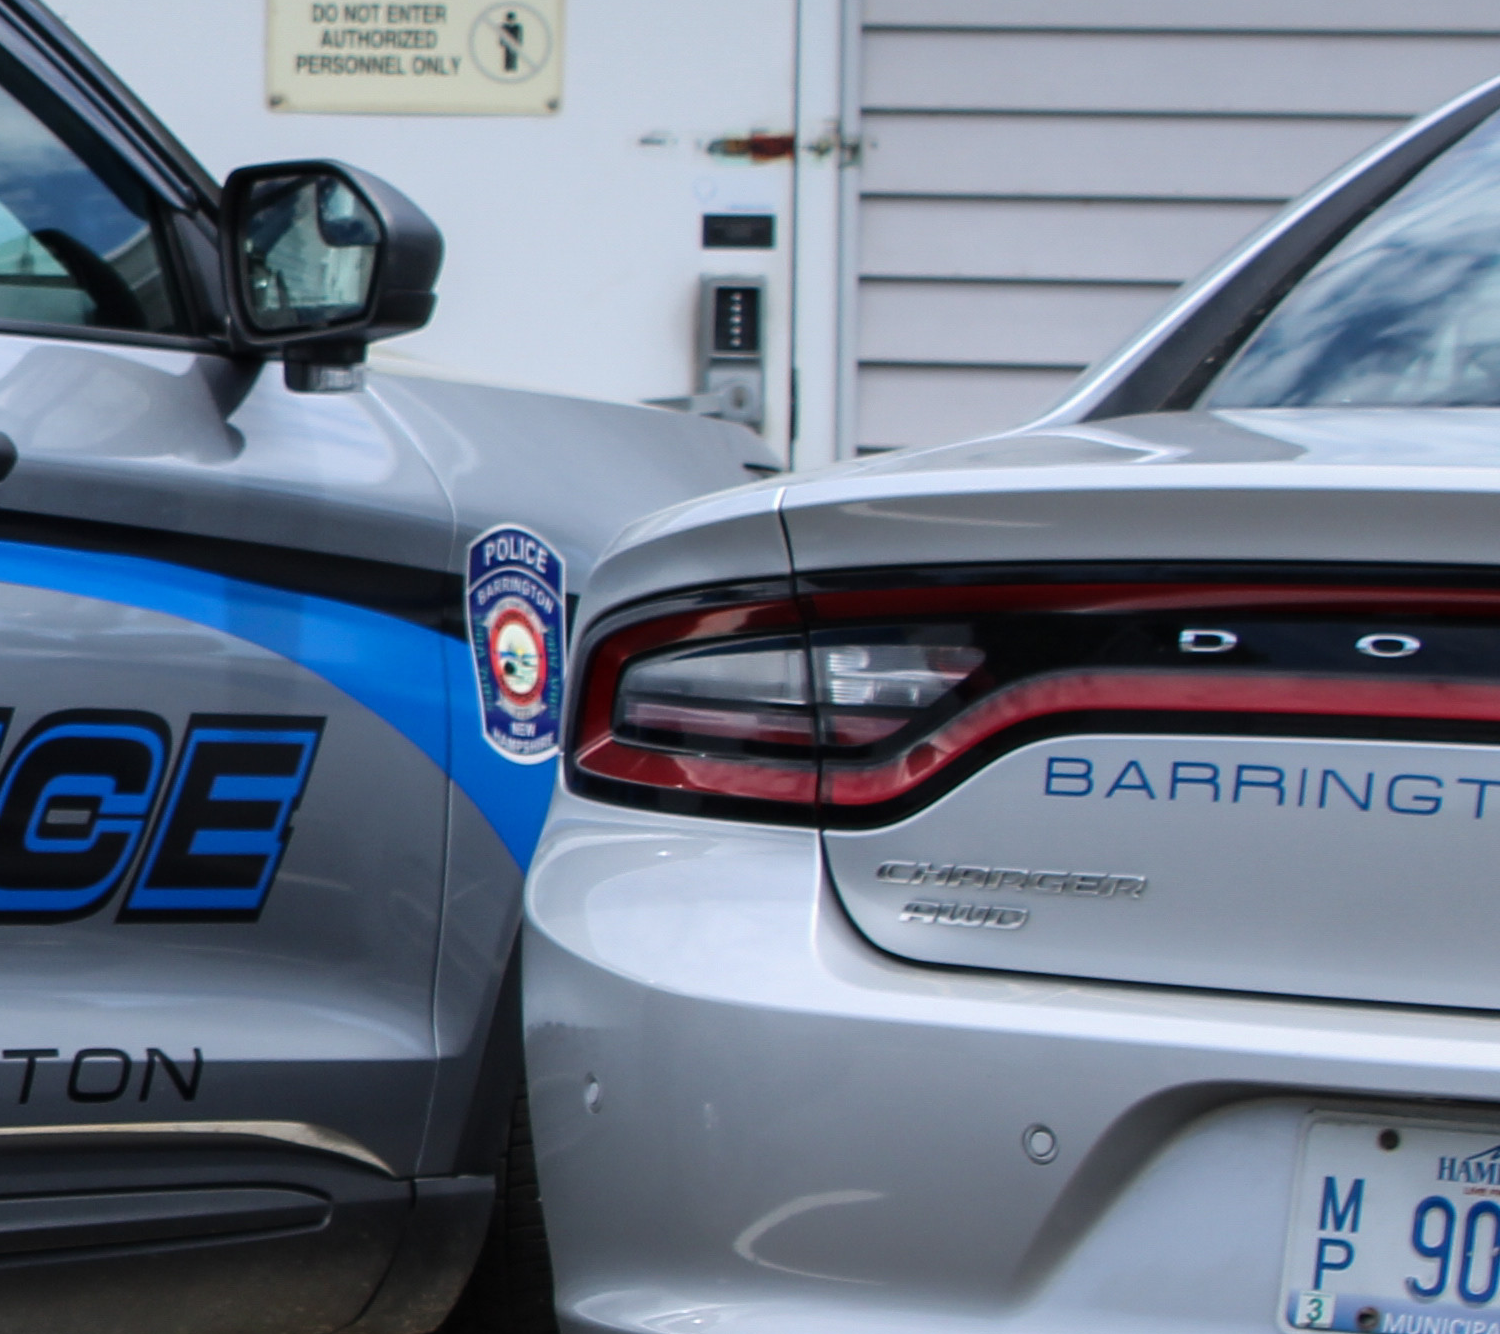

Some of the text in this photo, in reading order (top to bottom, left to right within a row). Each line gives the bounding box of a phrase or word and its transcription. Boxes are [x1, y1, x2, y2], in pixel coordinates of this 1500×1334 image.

[312, 3, 448, 25] DO NOT ENTER
[320, 29, 438, 50] AUTHORIZED
[296, 54, 462, 77] PERSONNEL ONLY
[483, 536, 549, 574] POLICE
[477, 575, 555, 615] BARRINGTON
[875, 859, 1148, 899] CHARGER
[899, 899, 1029, 929] AWD
[1436, 1156, 1500, 1185] HAM
[1306, 1298, 1324, 1322] 3
